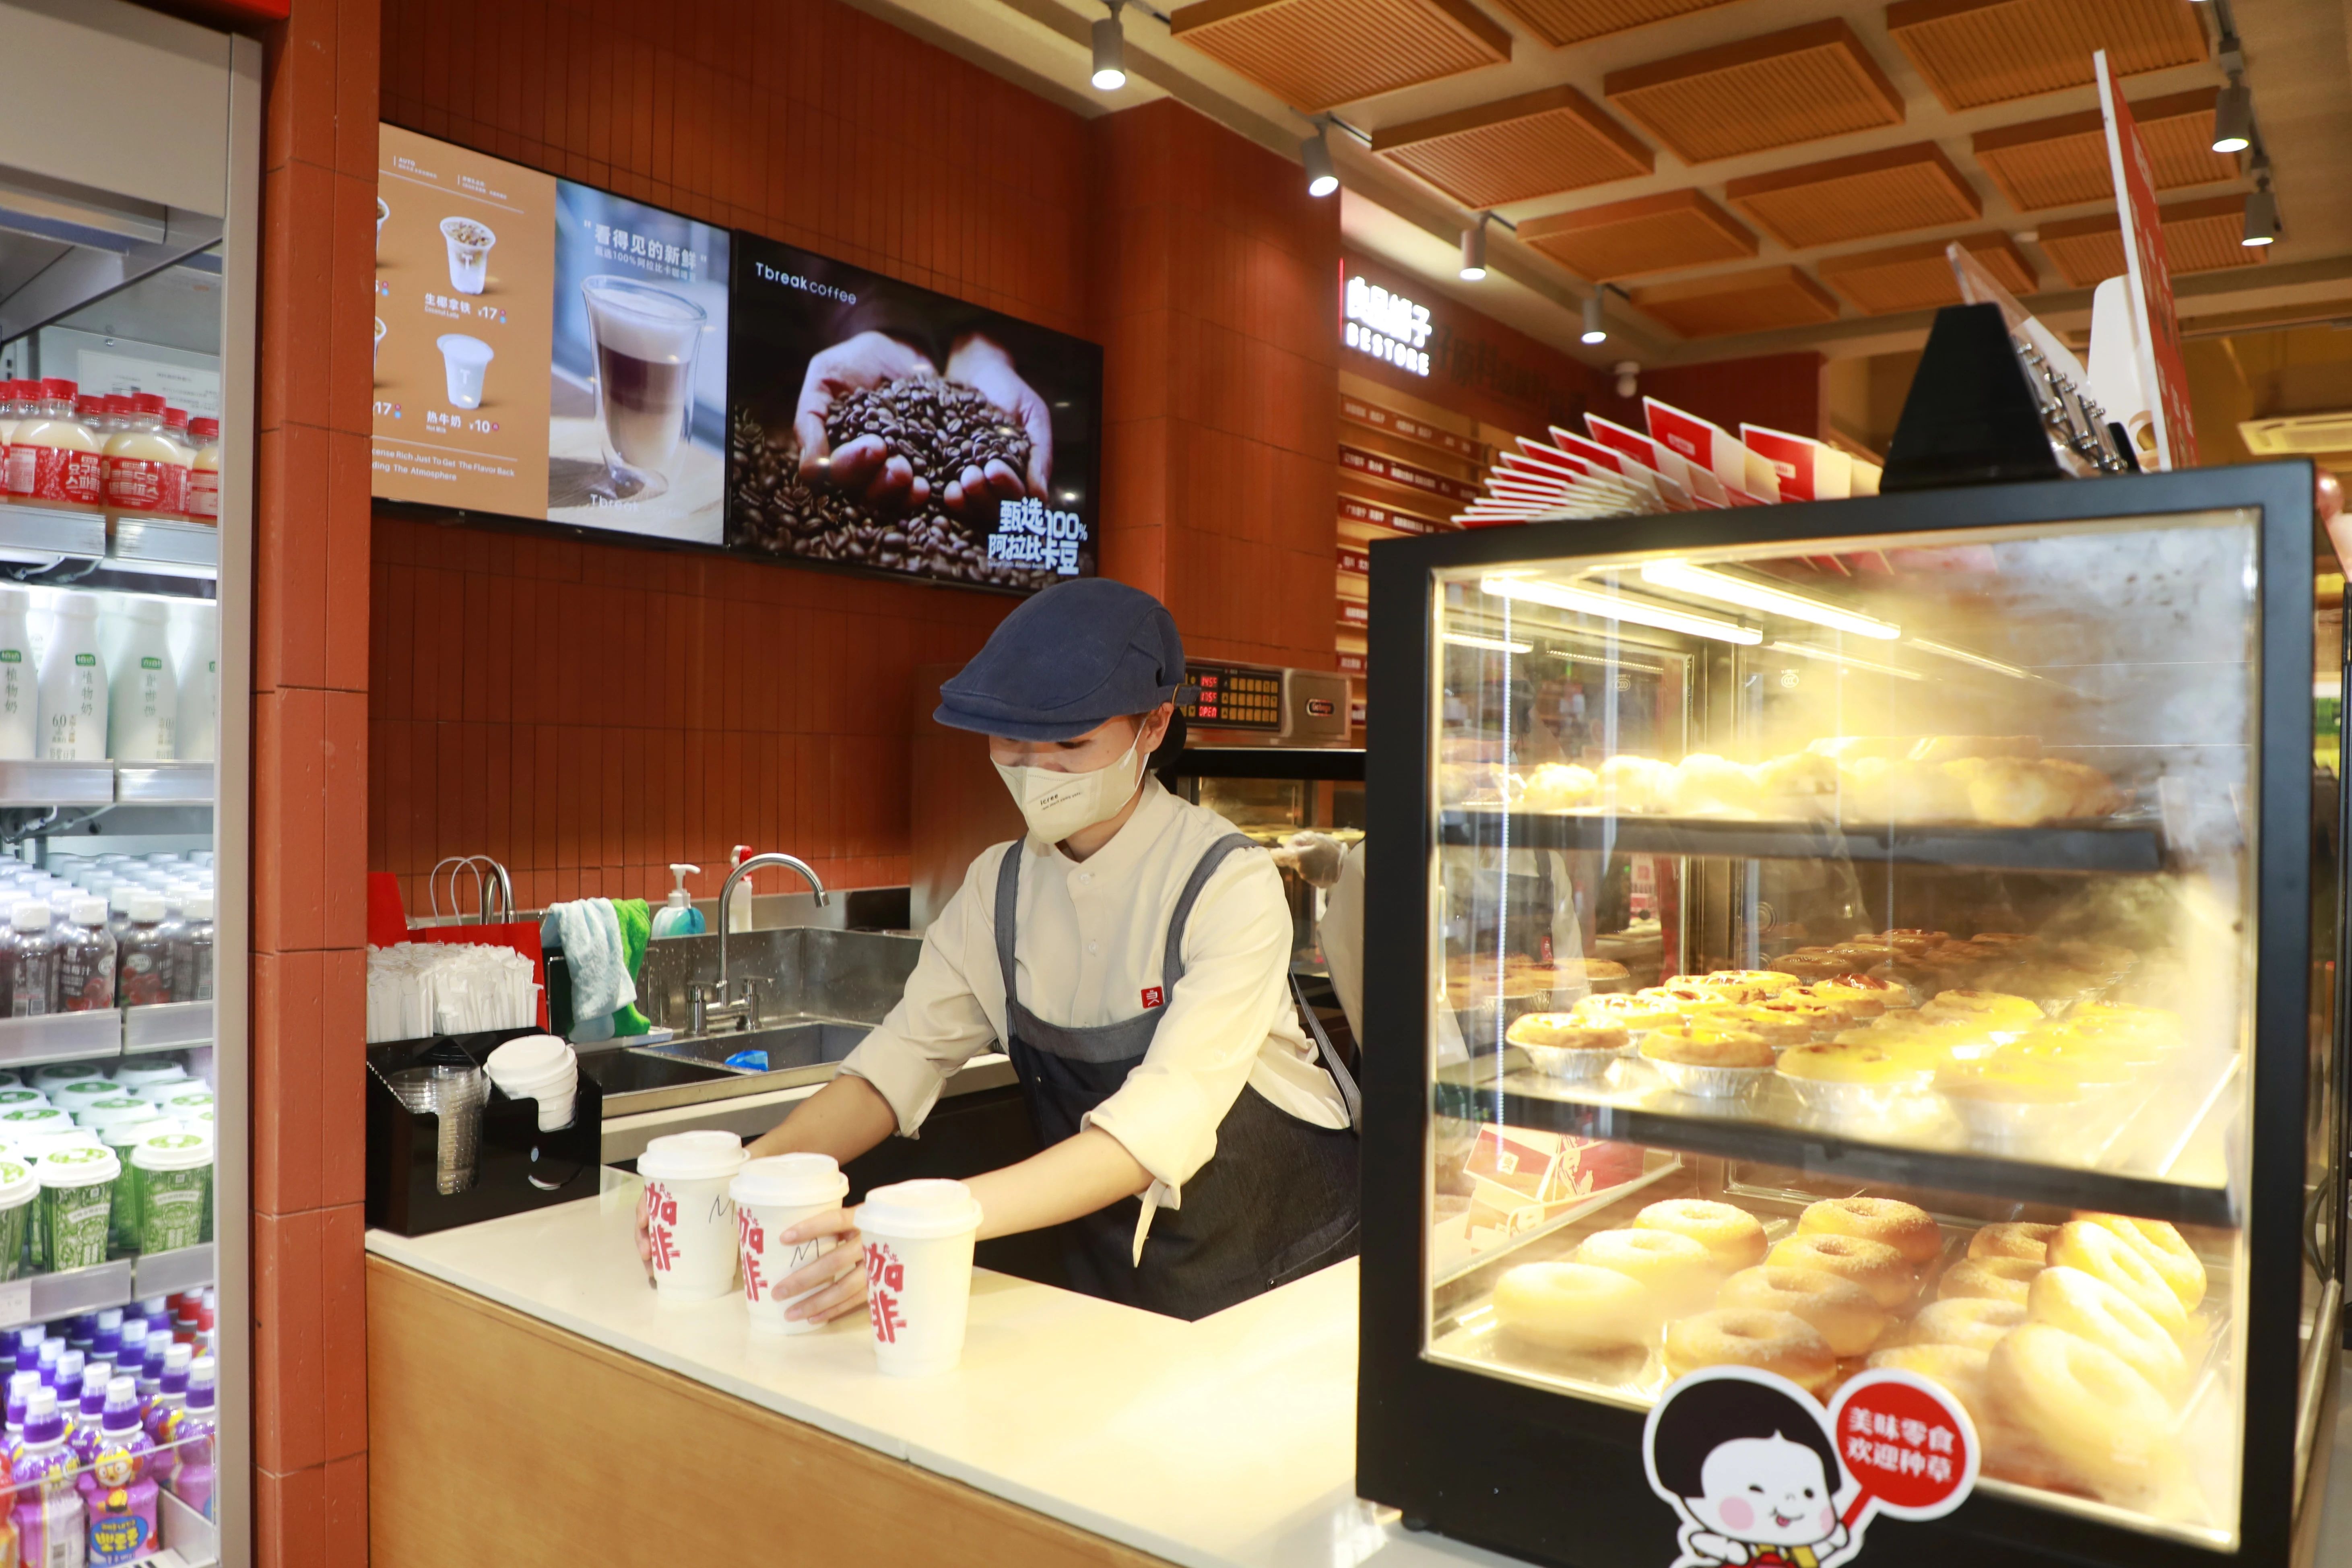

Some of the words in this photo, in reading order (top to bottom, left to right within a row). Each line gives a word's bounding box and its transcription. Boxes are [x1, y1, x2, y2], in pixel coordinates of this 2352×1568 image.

[398, 157, 415, 166] AUTO
[755, 262, 807, 291] Tbreak
[809, 281, 856, 305] coffee
[425, 293, 471, 314] 生椰拿铁
[427, 411, 461, 428] 热牛奶
[394, 464, 408, 473] The
[411, 467, 457, 481] Atmosphere
[396, 451, 413, 461] Rich
[415, 454, 431, 464] Just
[432, 456, 442, 466] To
[443, 459, 456, 468] Get
[459, 461, 472, 470] The
[473, 463, 496, 474] Flavor
[497, 467, 515, 477] Back
[590, 493, 640, 512] Tbreak
[999, 496, 1088, 541] 甄选100%
[988, 534, 1079, 575] 阿拉比卡豆
[5, 667, 18, 714] 植物奶
[81, 671, 93, 716] 植物奶
[709, 1195, 735, 1225] M
[790, 1238, 819, 1267] M
[1848, 1405, 1955, 1455] 美味零食
[1846, 1436, 1953, 1483] 欢迎种草
